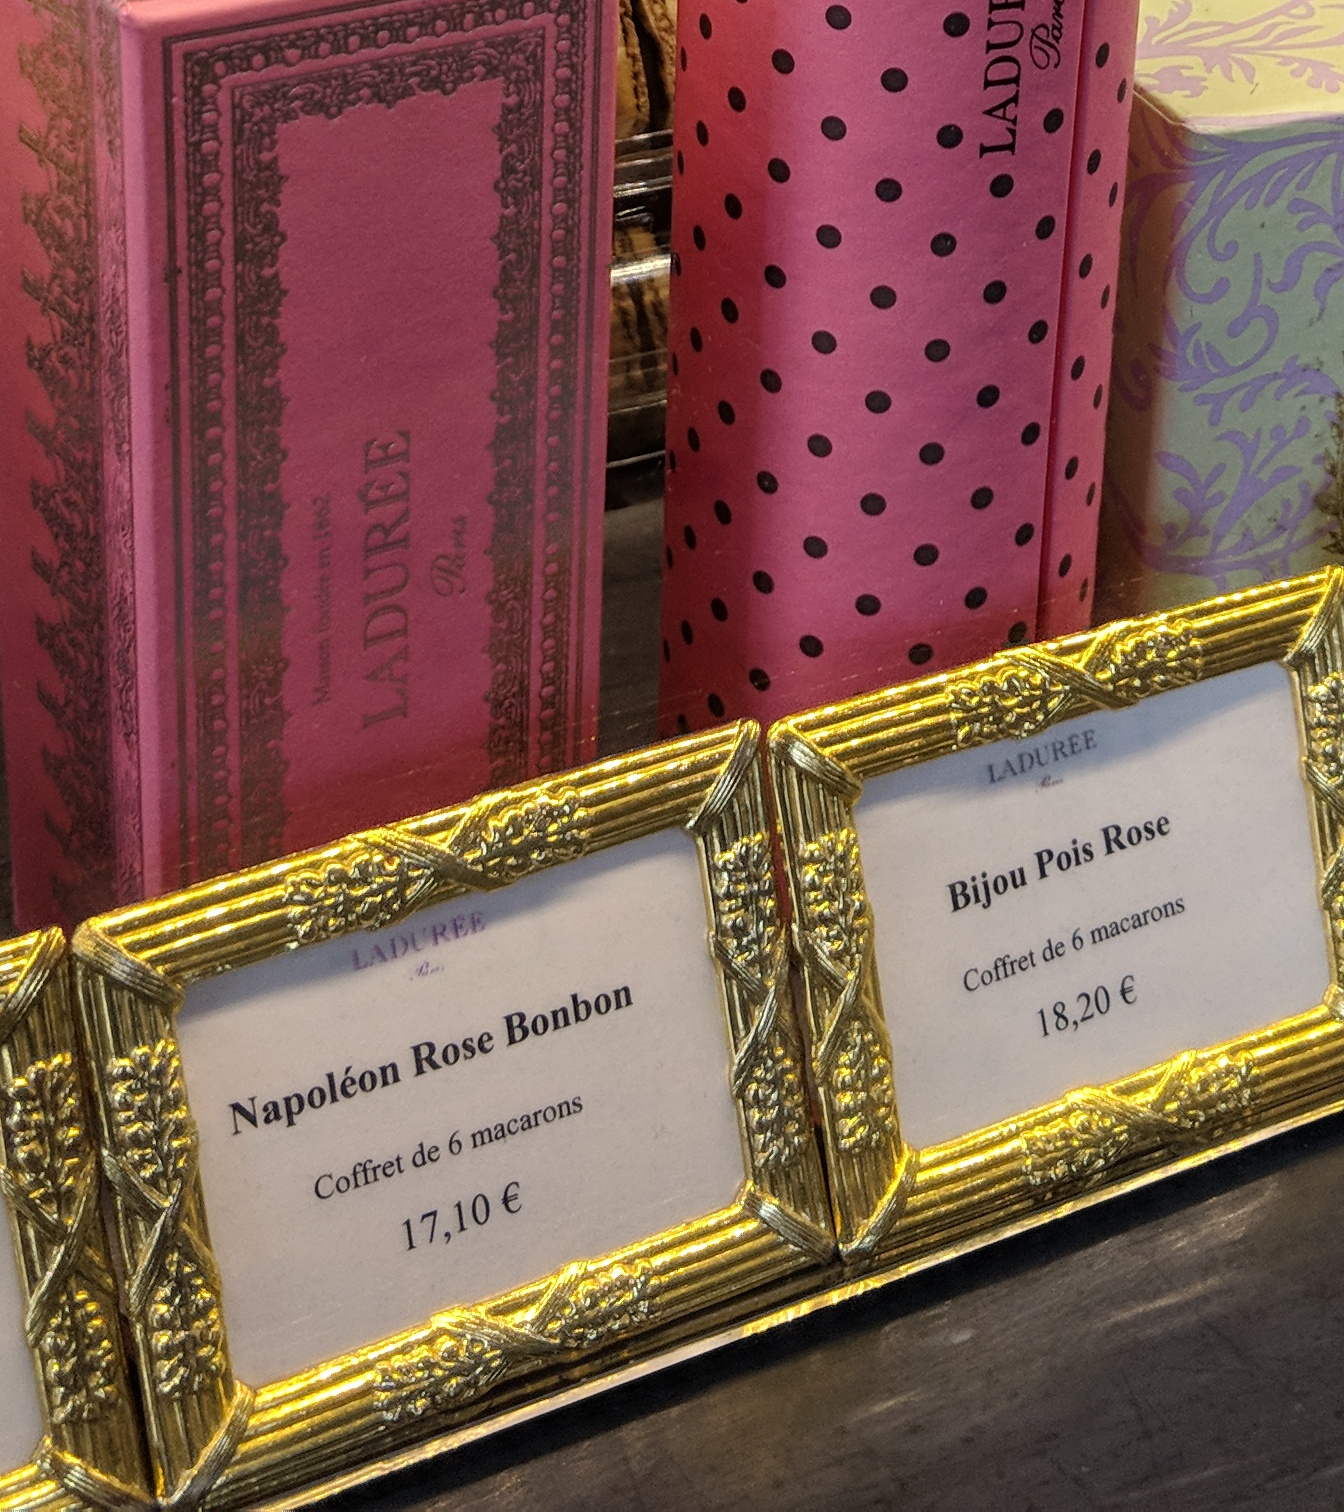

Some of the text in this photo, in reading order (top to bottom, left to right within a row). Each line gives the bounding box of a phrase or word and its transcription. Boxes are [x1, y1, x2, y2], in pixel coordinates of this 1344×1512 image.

[359, 430, 411, 729] LADURÉE
[431, 514, 467, 597] Paris
[947, 815, 1171, 913] Bijou Pois Rose
[963, 897, 1186, 992] Coffret de 6 macarons
[1037, 974, 1138, 1038] 18,20 €
[229, 985, 634, 1135] Napoléon Rose Bonbon
[314, 1095, 584, 1200] Coffret de 6 macarons
[401, 1181, 523, 1252] 17,10 €
